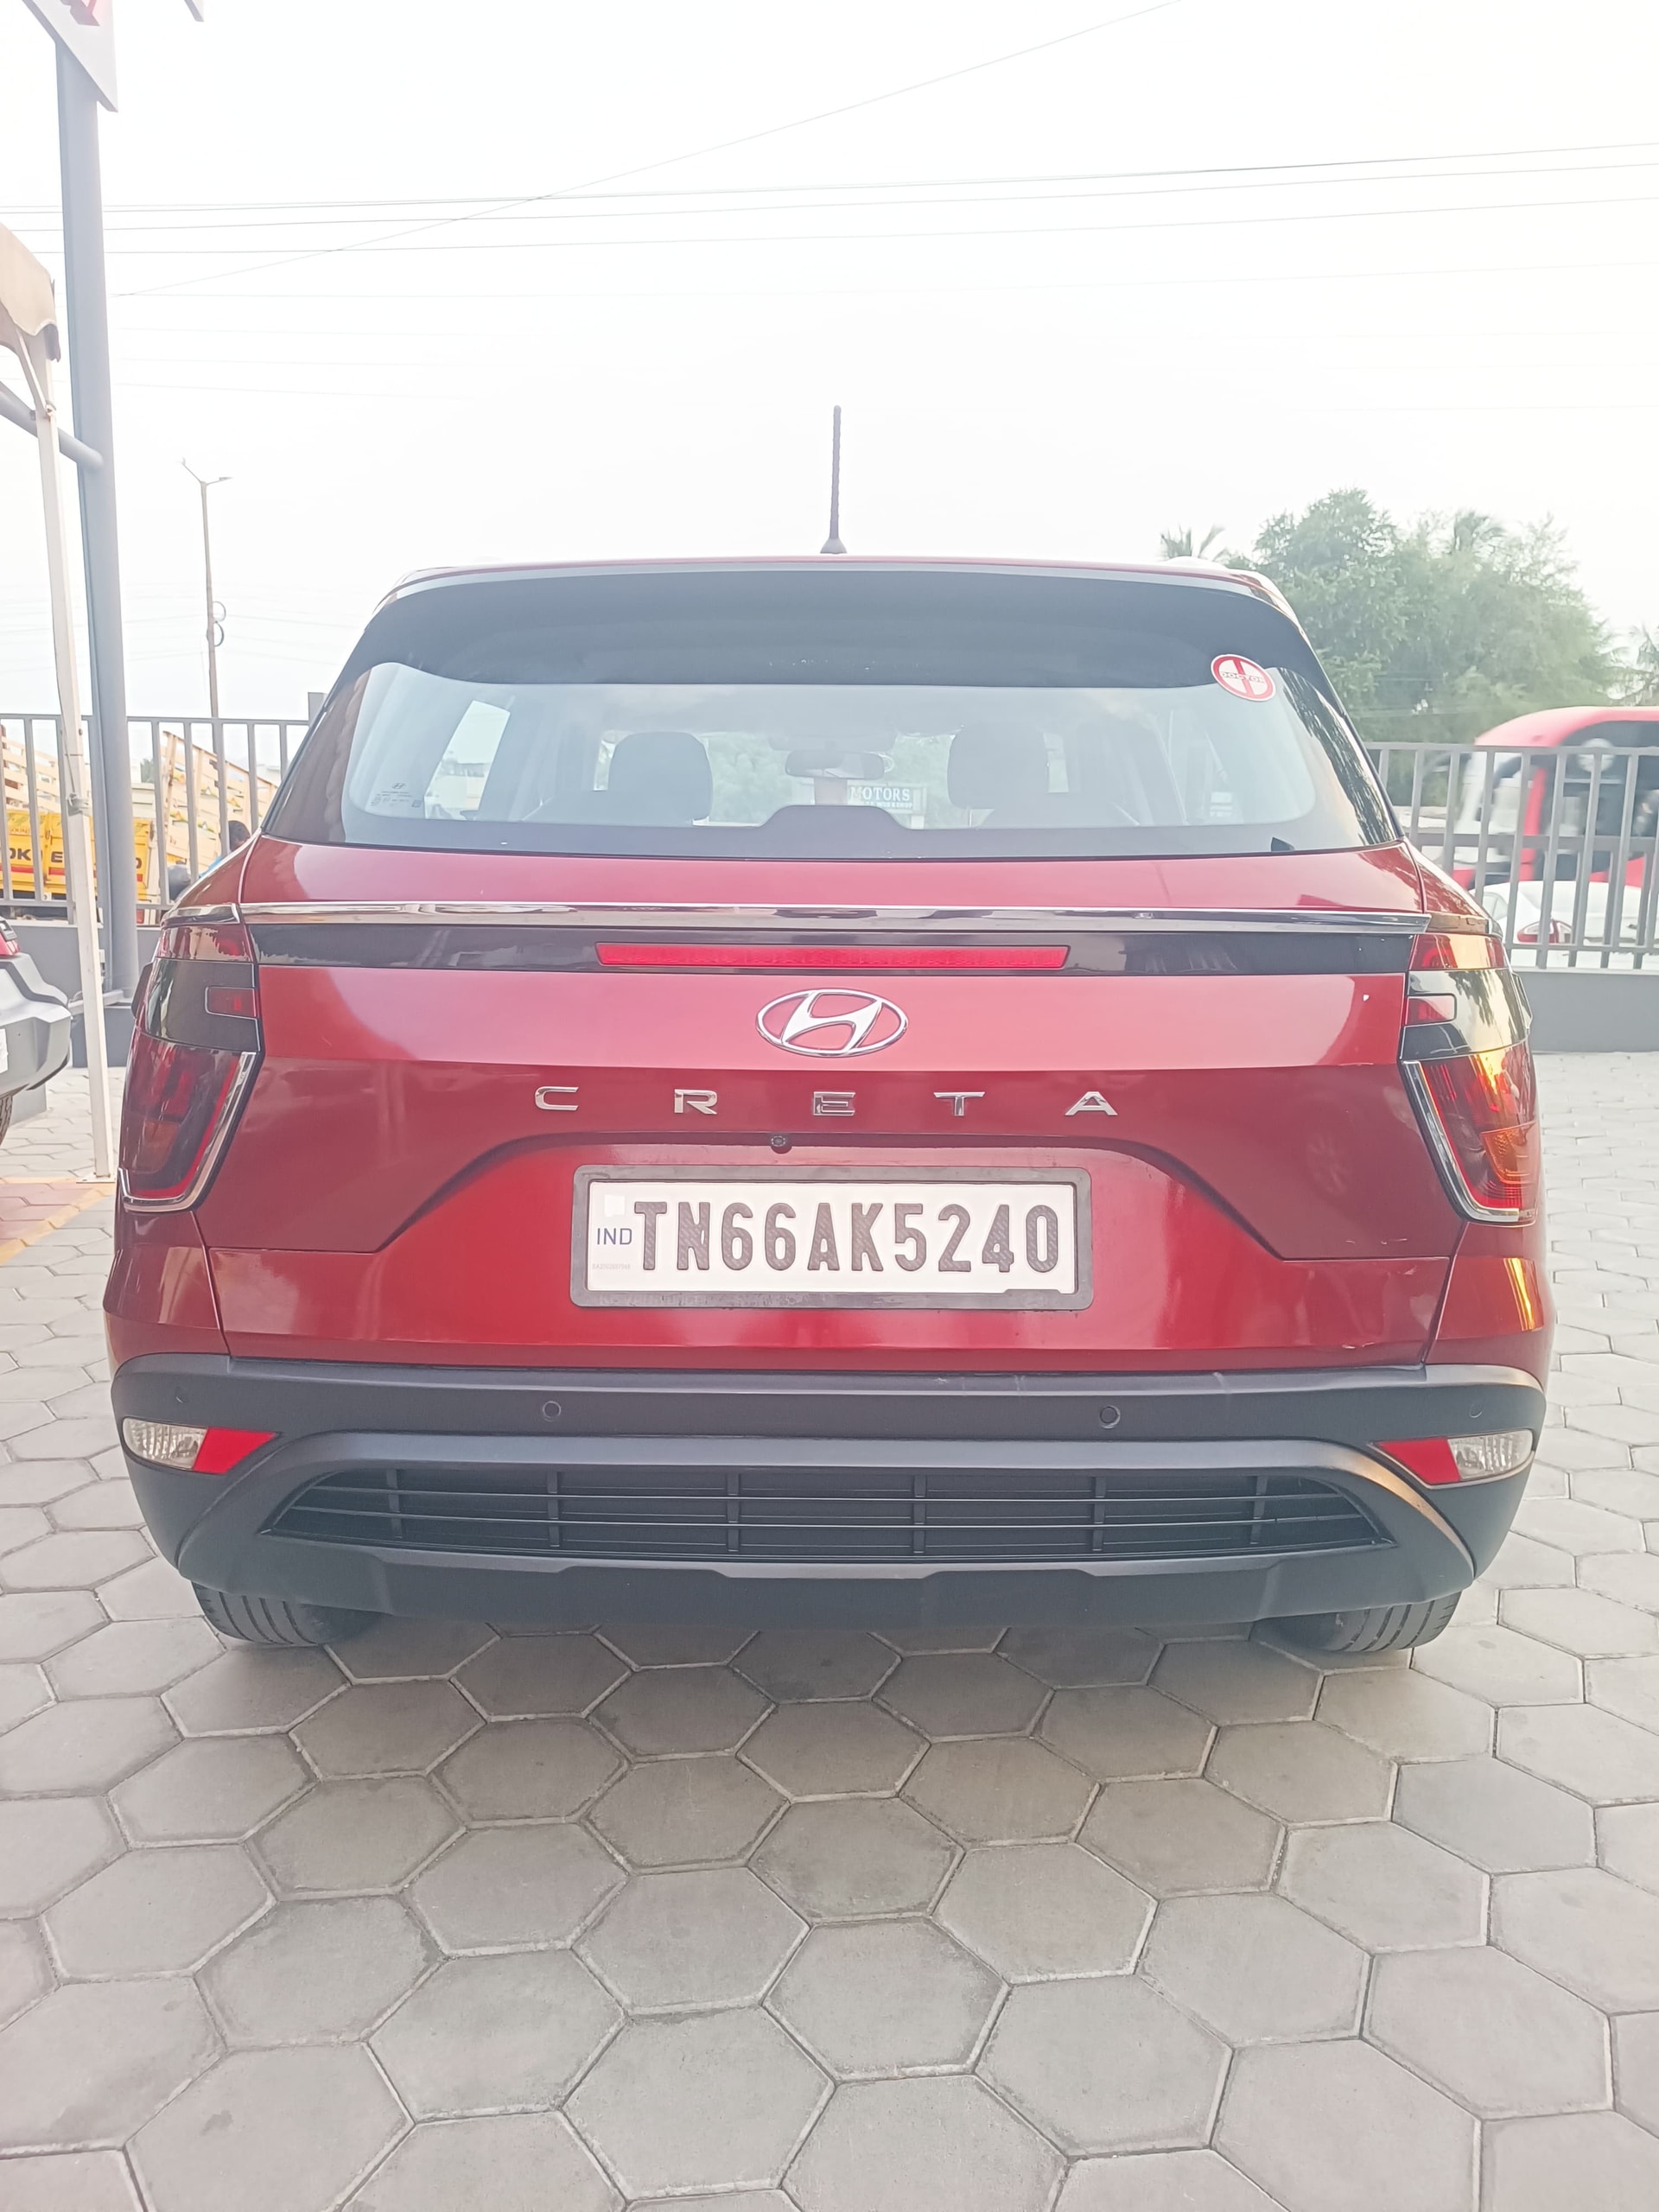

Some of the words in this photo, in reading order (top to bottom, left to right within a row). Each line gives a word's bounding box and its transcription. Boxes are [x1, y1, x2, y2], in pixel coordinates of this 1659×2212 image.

[850, 786, 910, 802] MOTORS
[534, 1085, 1118, 1116] CRETA
[596, 1227, 633, 1246] IND
[633, 1201, 1059, 1273] TN66AK5240
